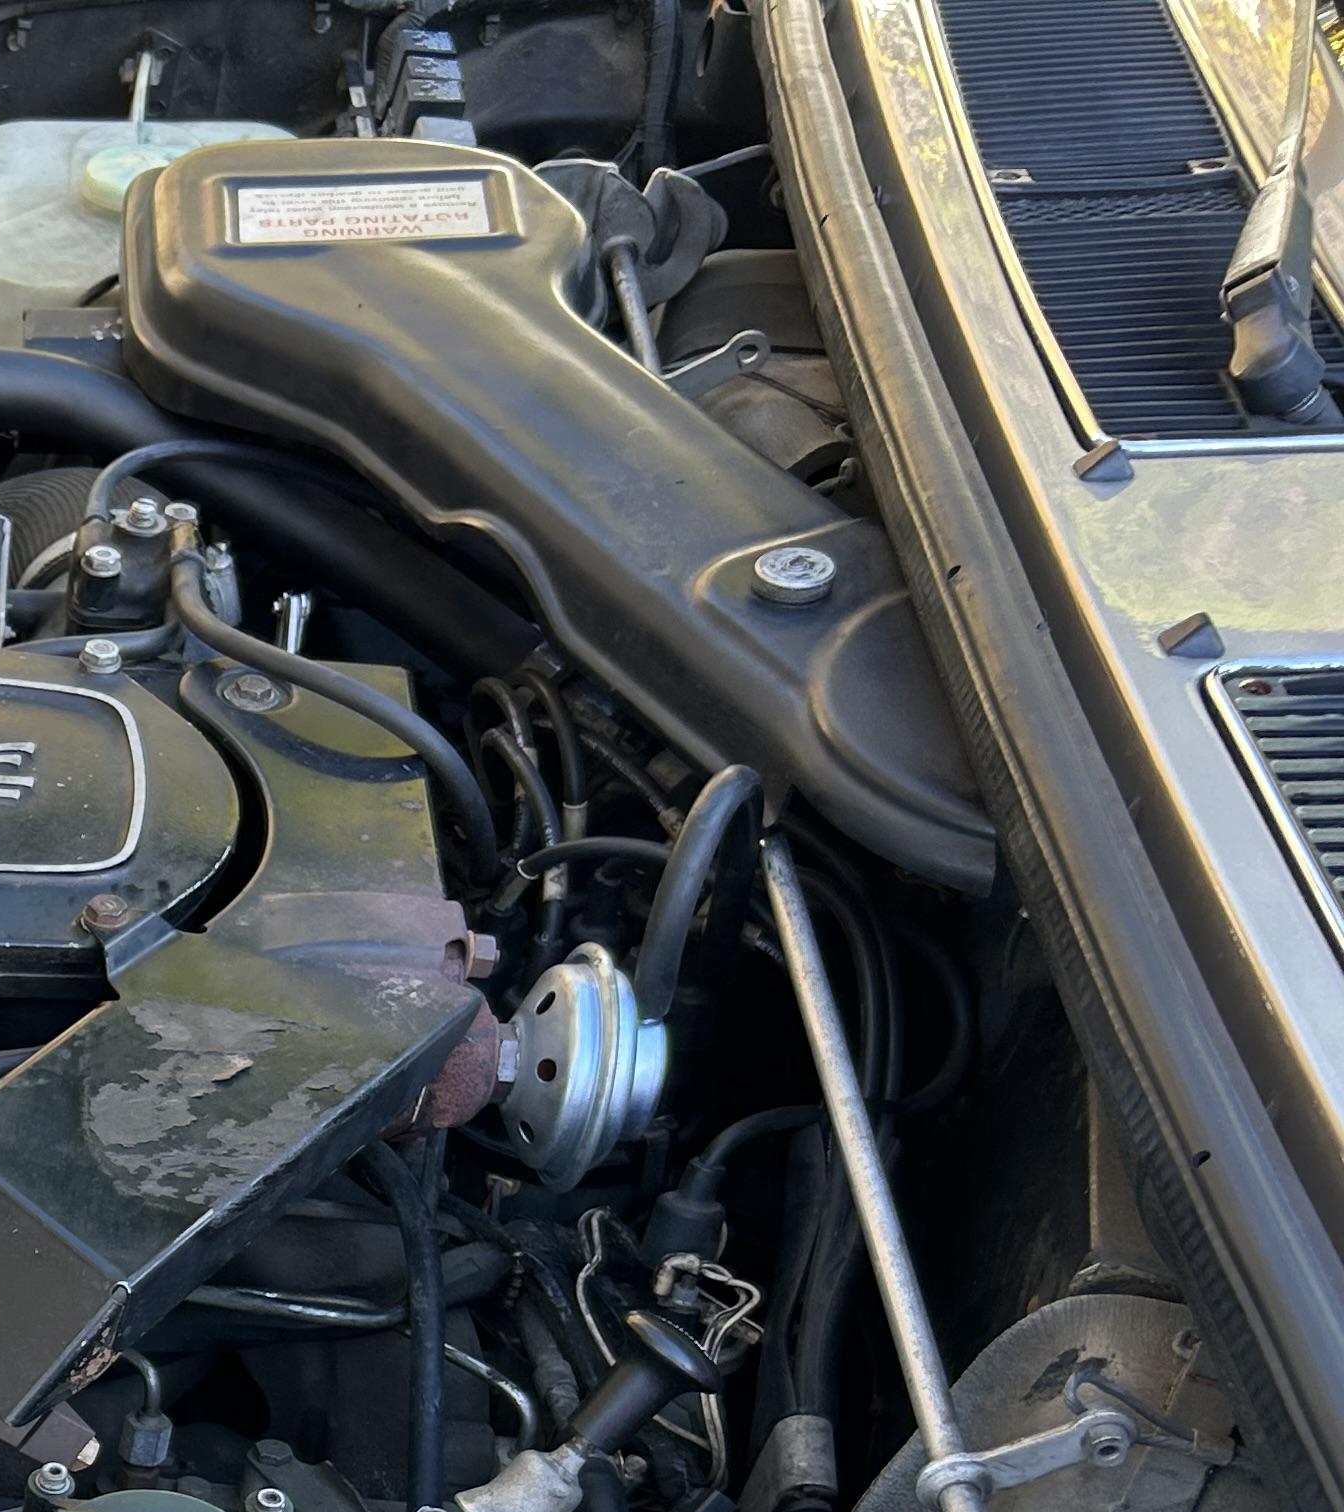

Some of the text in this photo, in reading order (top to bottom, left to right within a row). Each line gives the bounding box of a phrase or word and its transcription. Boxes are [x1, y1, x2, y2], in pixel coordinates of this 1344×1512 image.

[259, 212, 469, 229] ROTATING PARTS
[303, 225, 424, 238] WARNING
